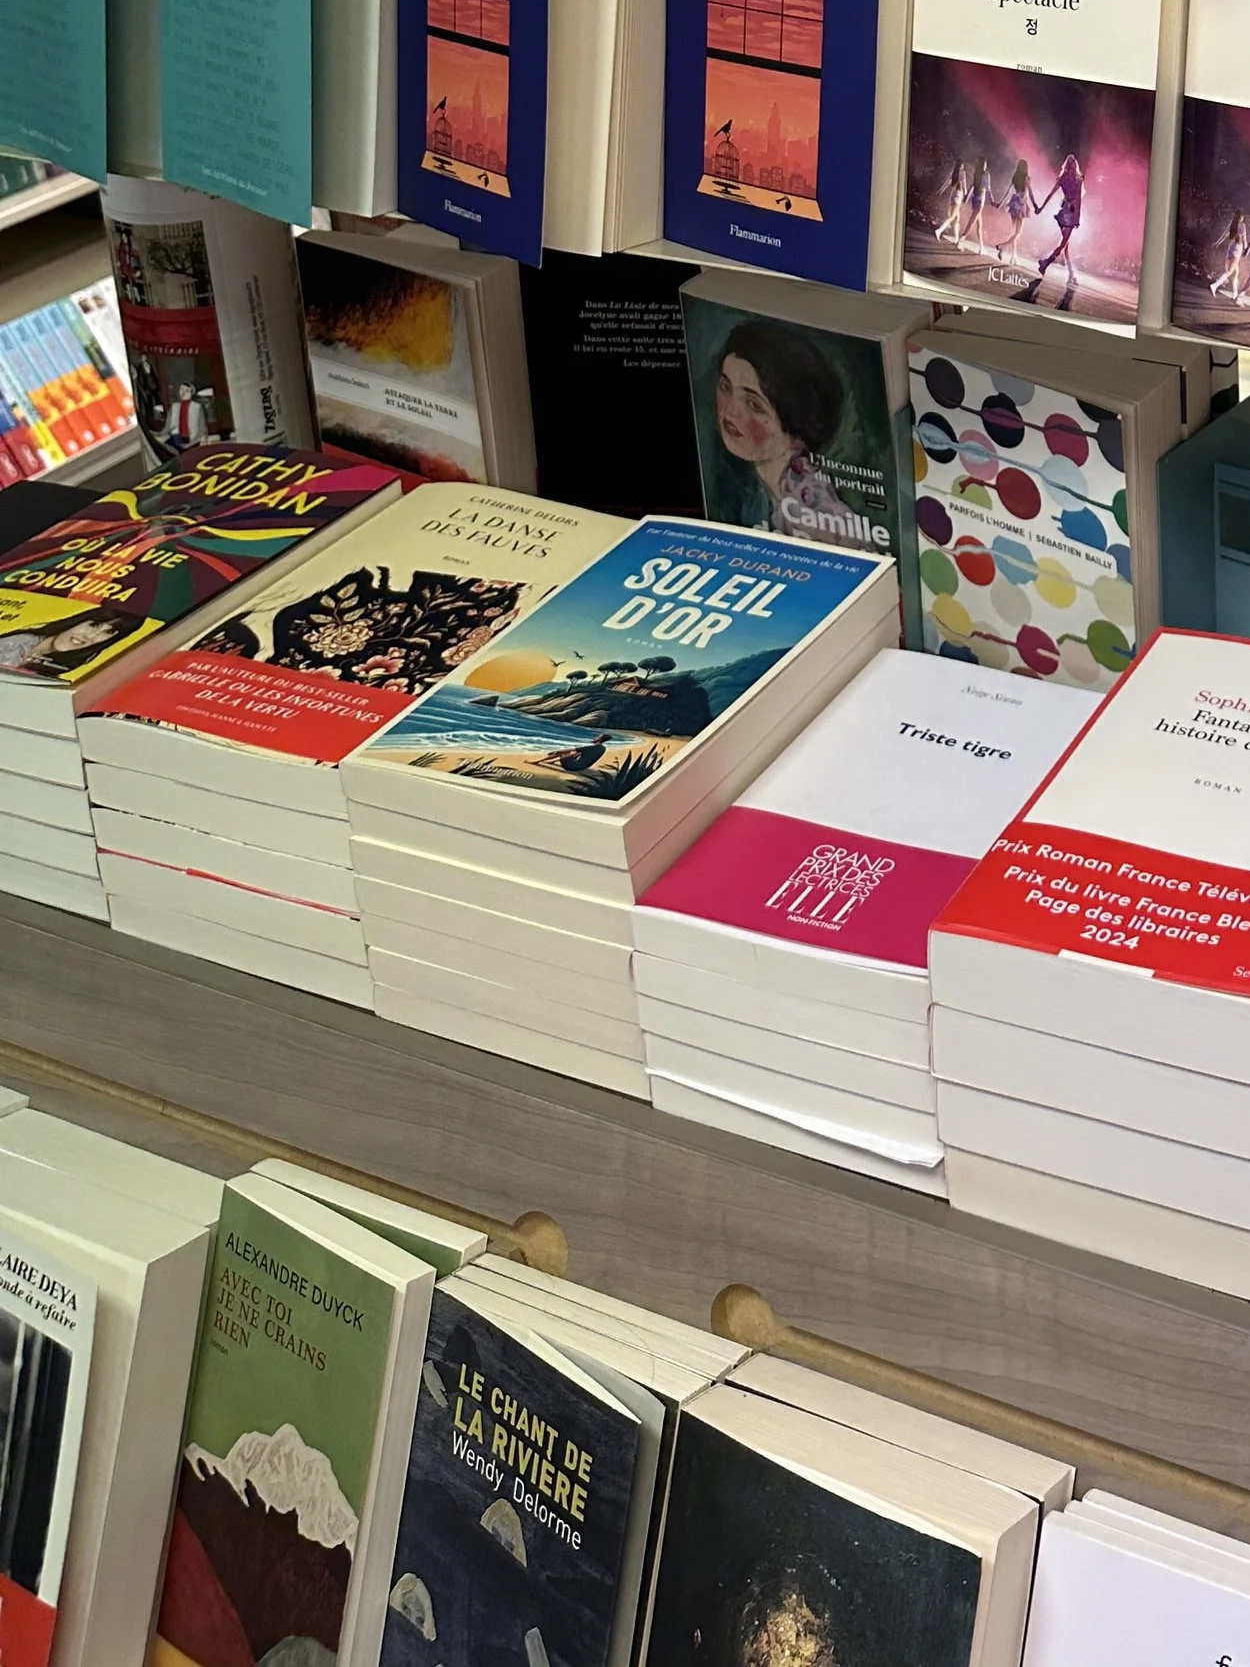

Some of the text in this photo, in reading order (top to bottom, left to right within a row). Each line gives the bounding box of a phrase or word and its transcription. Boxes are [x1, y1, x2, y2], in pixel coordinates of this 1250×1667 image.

[133, 473, 326, 516] BONIDAN
[195, 452, 332, 487] CATHY
[421, 519, 552, 559] DES FAUVES
[447, 508, 564, 543] LA DANSE
[782, 496, 890, 546] Camille
[949, 502, 1112, 570] PARFOIS L'HOMME SÉBASTIEN BAILLY
[625, 558, 787, 619] SOLEIL
[603, 595, 733, 649] D'OR
[898, 722, 1012, 763] Triste tigre
[1154, 719, 1240, 752] histoire
[992, 836, 1032, 861] Prix
[1037, 841, 1111, 873] Roman
[1118, 858, 1193, 895] France
[225, 1232, 365, 1332] ALEXANDRE DUYCK
[458, 1363, 593, 1483] LE CHANT DE
[453, 1398, 587, 1523] LA RIVIERE
[452, 1433, 582, 1550] Wendy Delorme
